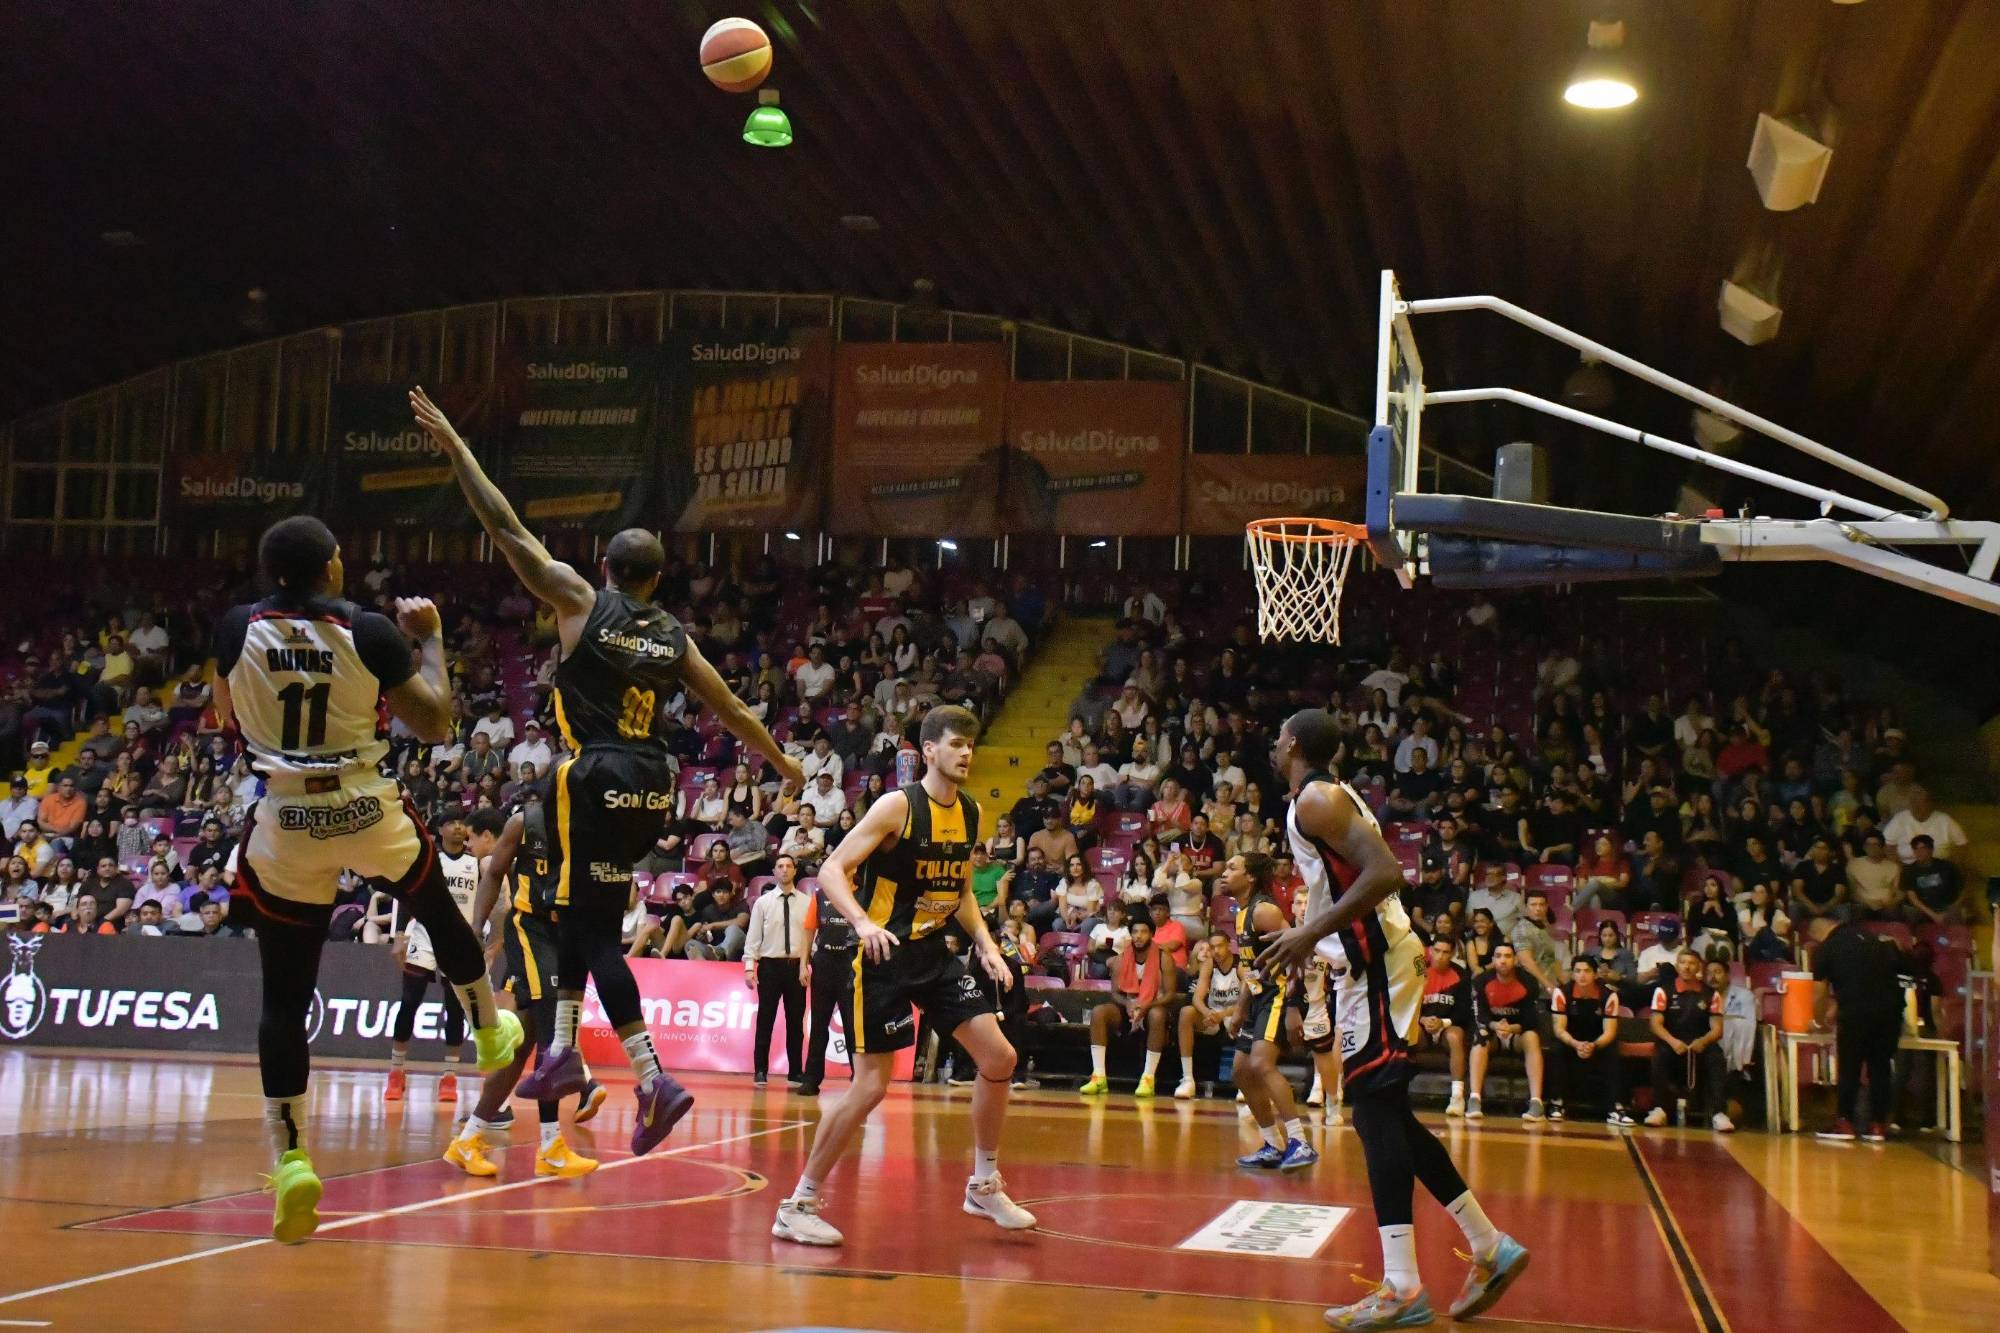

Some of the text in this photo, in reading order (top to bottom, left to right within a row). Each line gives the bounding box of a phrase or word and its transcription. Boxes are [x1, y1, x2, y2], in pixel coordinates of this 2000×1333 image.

[690, 342, 801, 365] SaludDigna
[526, 362, 629, 383] SaludDigna
[857, 363, 979, 390] SaludDigna
[345, 431, 471, 457] SaludDig
[1020, 430, 1159, 458] SaludDigna
[181, 477, 304, 502] SaludDigna
[1201, 481, 1345, 510] SaludDigna
[599, 628, 676, 658] SaludDigna
[278, 682, 331, 751] 11
[282, 808, 305, 828] El
[310, 798, 379, 828] Florido
[49, 988, 219, 1030] TUFESA
[327, 998, 475, 1040] TUE
